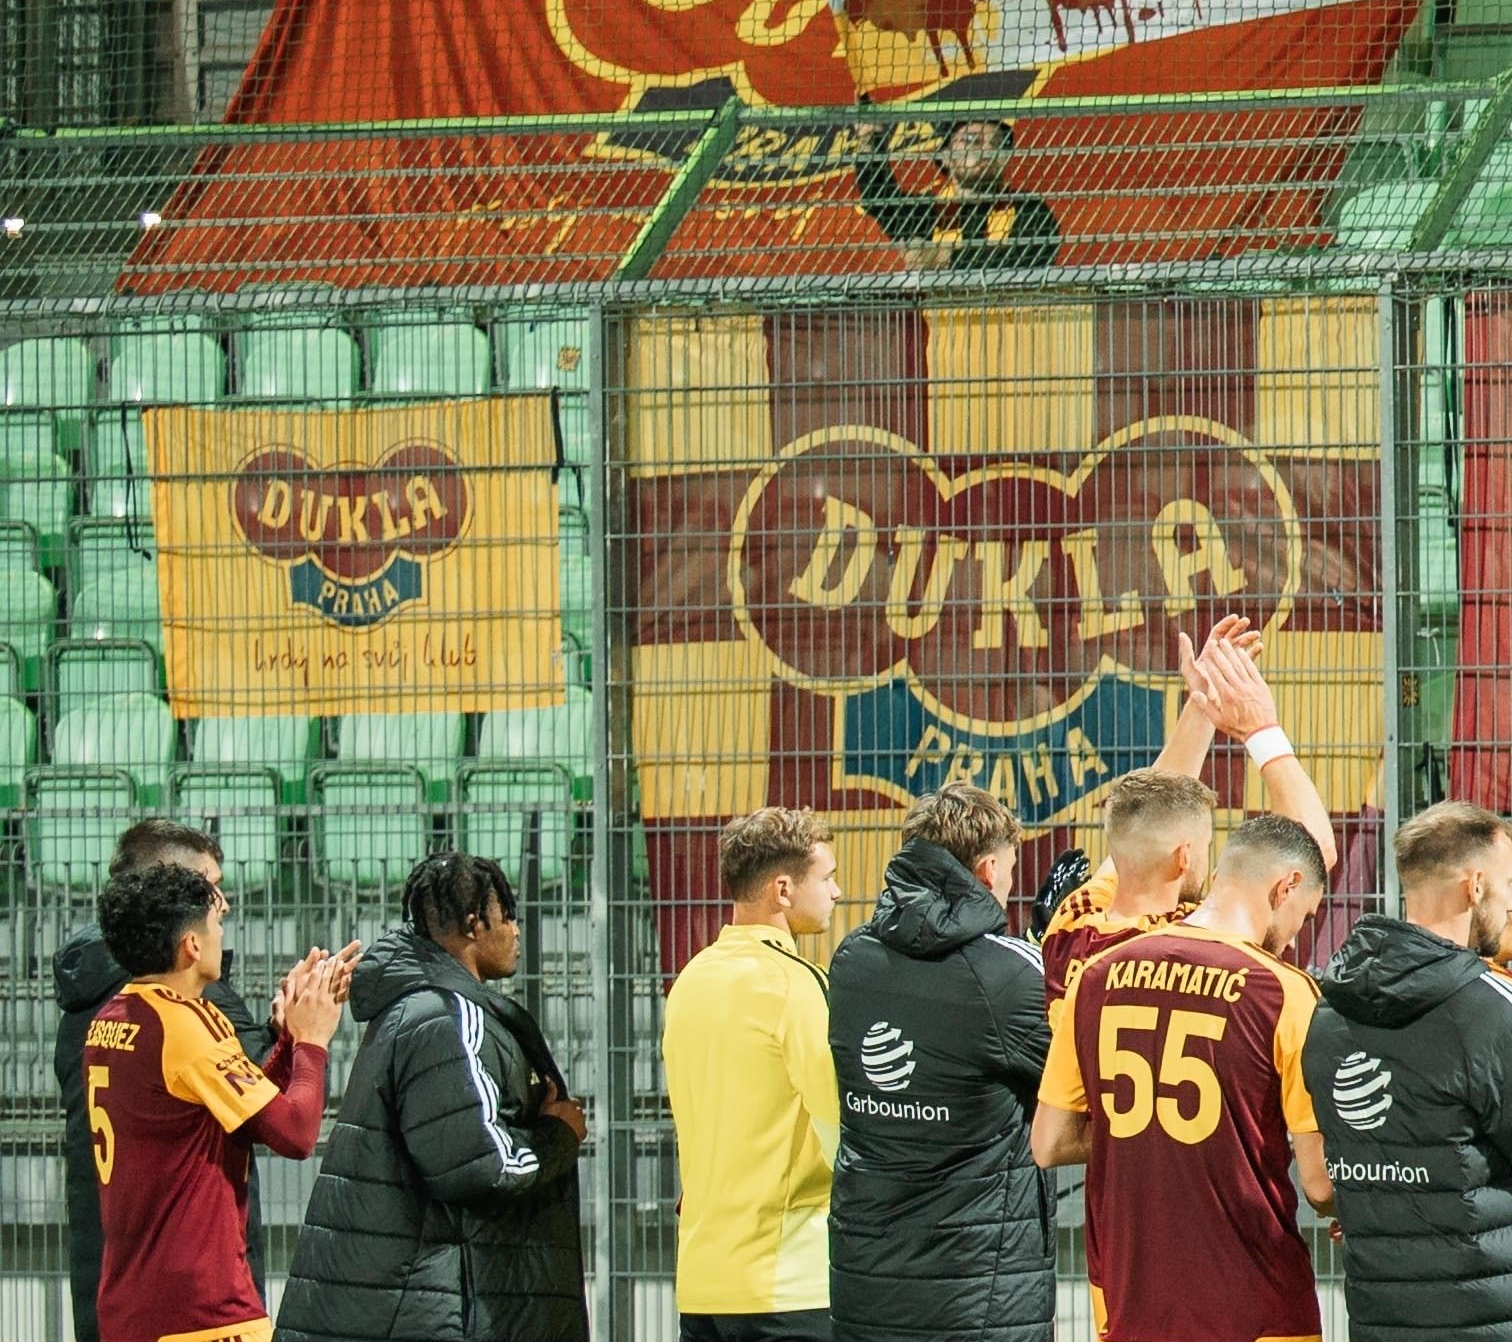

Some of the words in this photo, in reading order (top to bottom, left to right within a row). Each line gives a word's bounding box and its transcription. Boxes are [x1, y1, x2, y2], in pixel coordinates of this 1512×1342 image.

[257, 474, 448, 544] DUKLA
[788, 494, 1248, 650] DUKLA
[317, 578, 400, 616] PRAHA
[321, 652, 350, 669] na
[1105, 959, 1248, 1004] KARAMATIĆ
[1098, 1004, 1228, 1146] 55
[847, 1090, 950, 1122] Carbounion
[1324, 1156, 1430, 1184] arbounion
